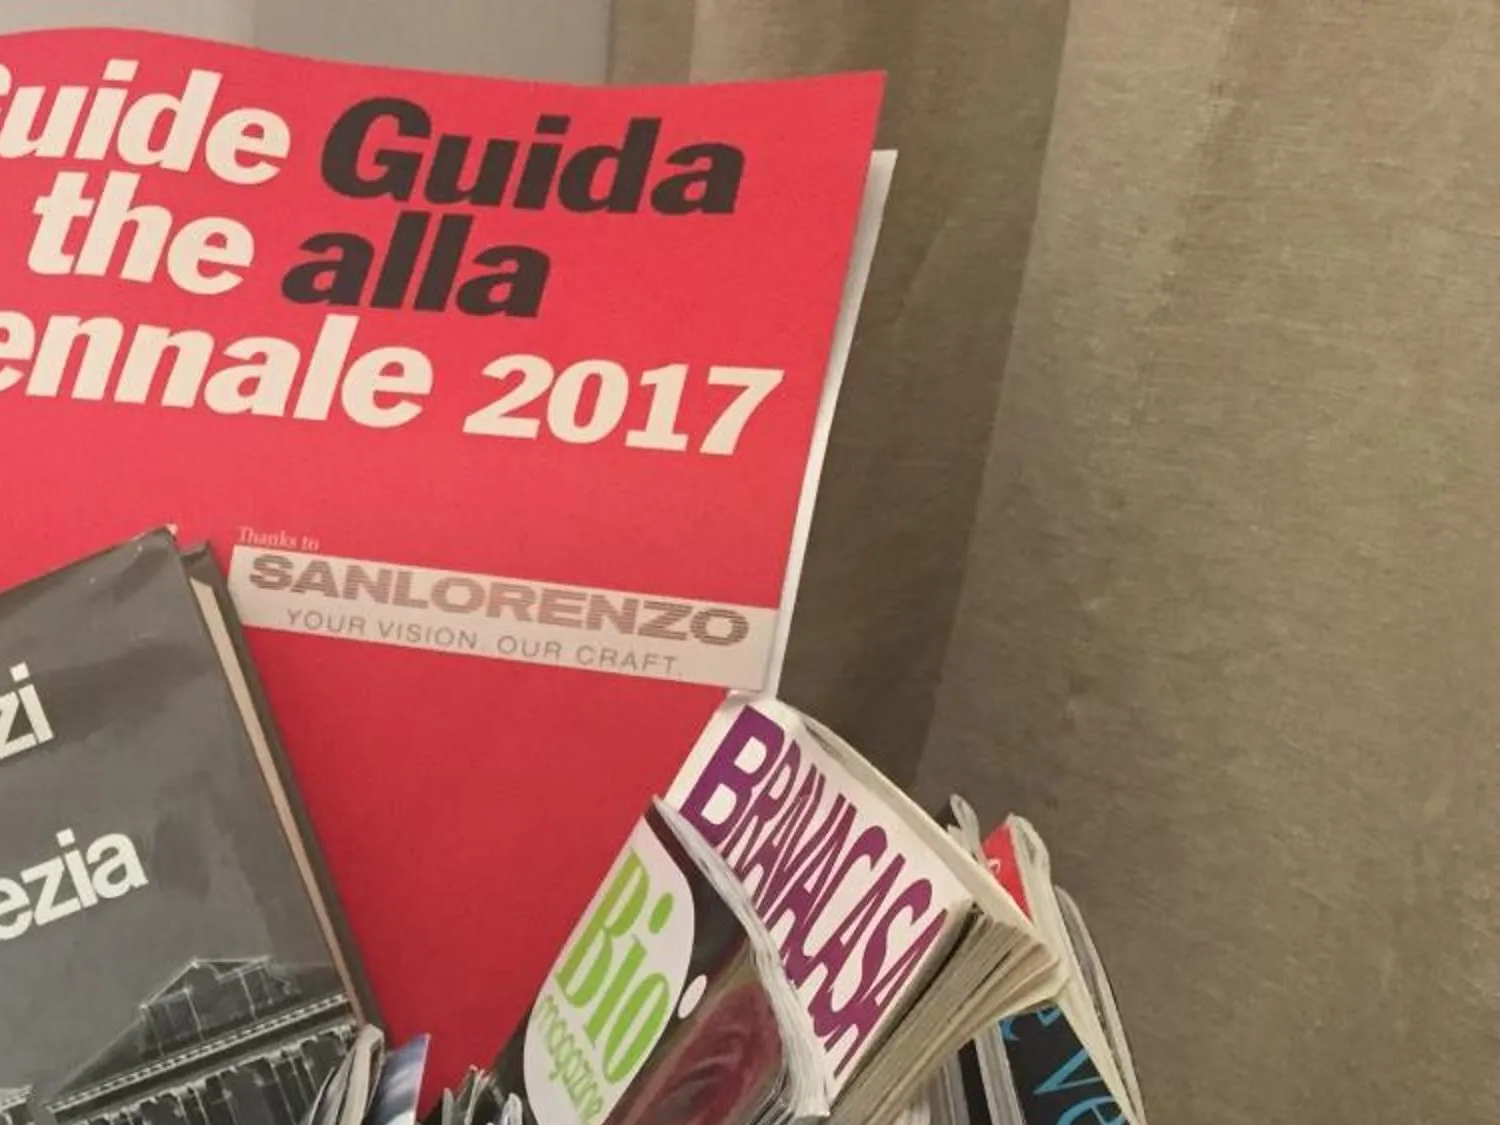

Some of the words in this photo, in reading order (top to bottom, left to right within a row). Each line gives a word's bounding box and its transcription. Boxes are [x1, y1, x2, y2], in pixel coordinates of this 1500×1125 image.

[321, 96, 746, 216] Guida
[26, 166, 254, 295] the
[280, 211, 551, 319] alla
[462, 355, 783, 456] 2017
[238, 527, 297, 549] Thanks
[301, 534, 319, 551] to
[249, 554, 749, 646] SANLORENZO
[286, 608, 366, 633] YOUR
[497, 634, 561, 660] OUR
[679, 704, 948, 1079] BRAVACASA
[555, 849, 673, 1085] Bio
